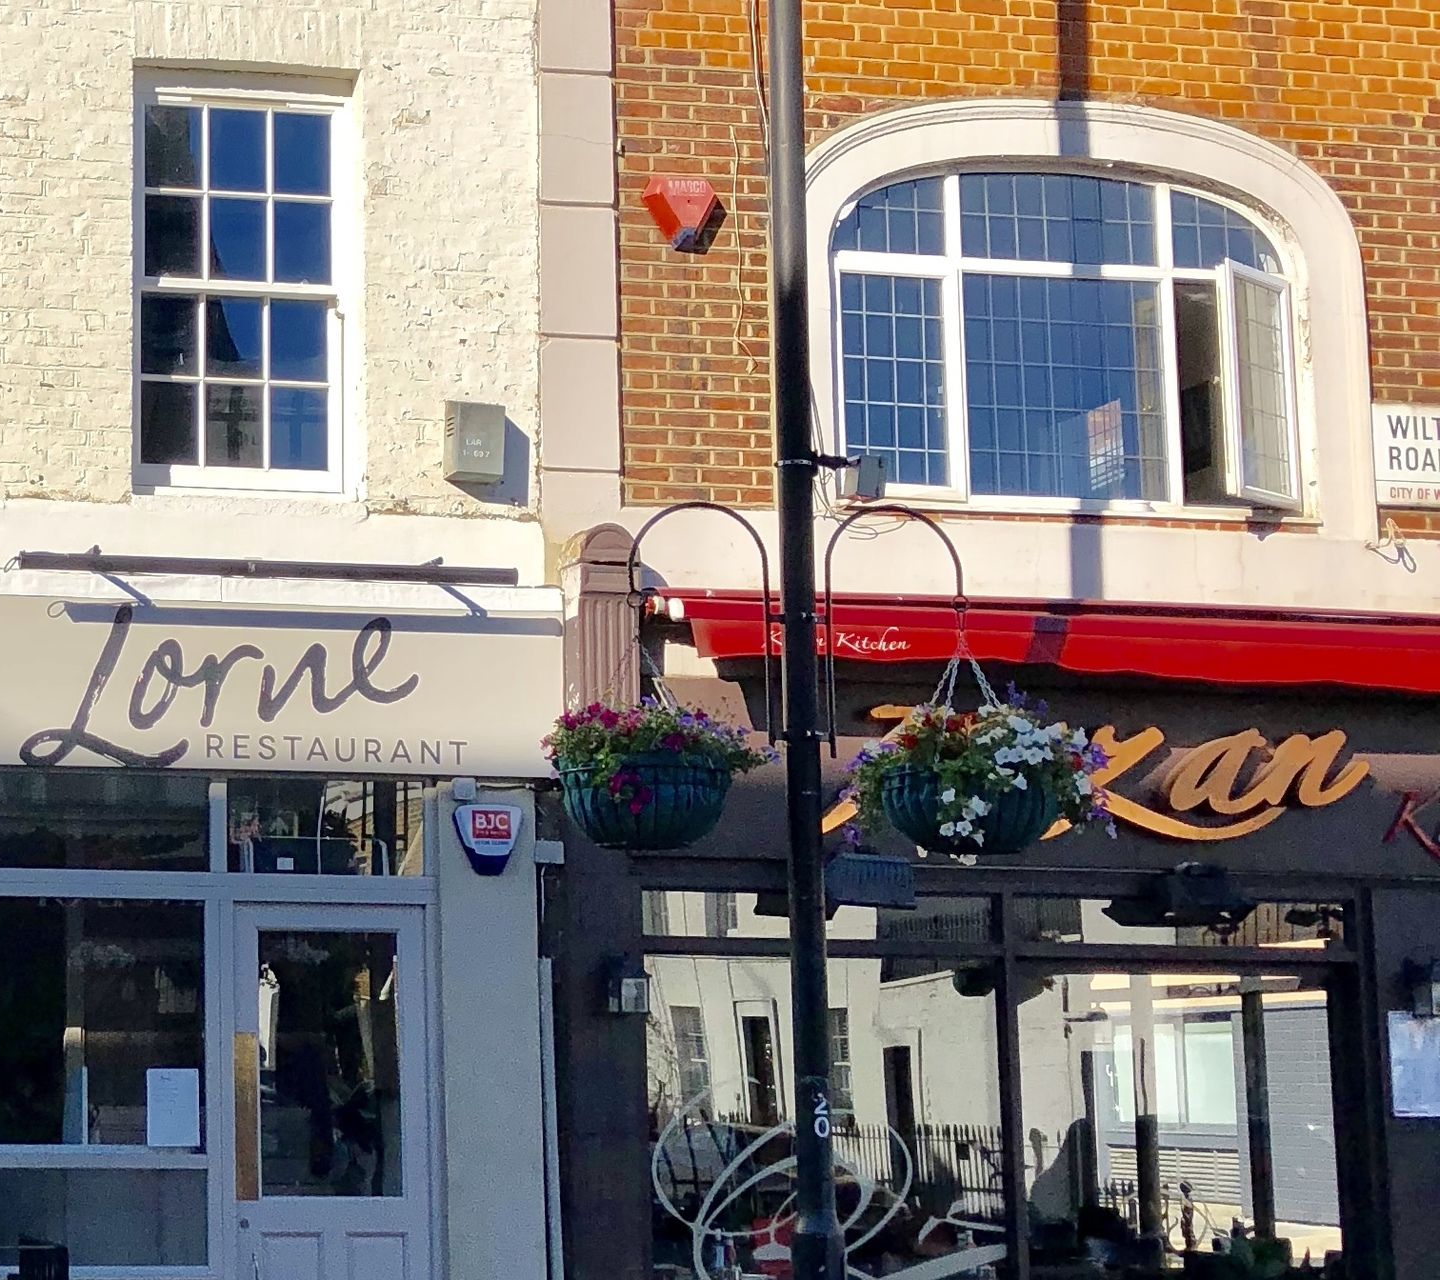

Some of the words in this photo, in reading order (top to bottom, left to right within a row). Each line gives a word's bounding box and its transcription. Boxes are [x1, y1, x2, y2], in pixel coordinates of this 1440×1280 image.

[1389, 446, 1440, 472] ROA
[1390, 487, 1413, 499] CITY
[1417, 488, 1431, 500] OF
[835, 626, 911, 654] Kitchen
[19, 603, 419, 767] Lorne
[206, 734, 469, 766] RESTAURANT
[475, 813, 508, 829] BJC
